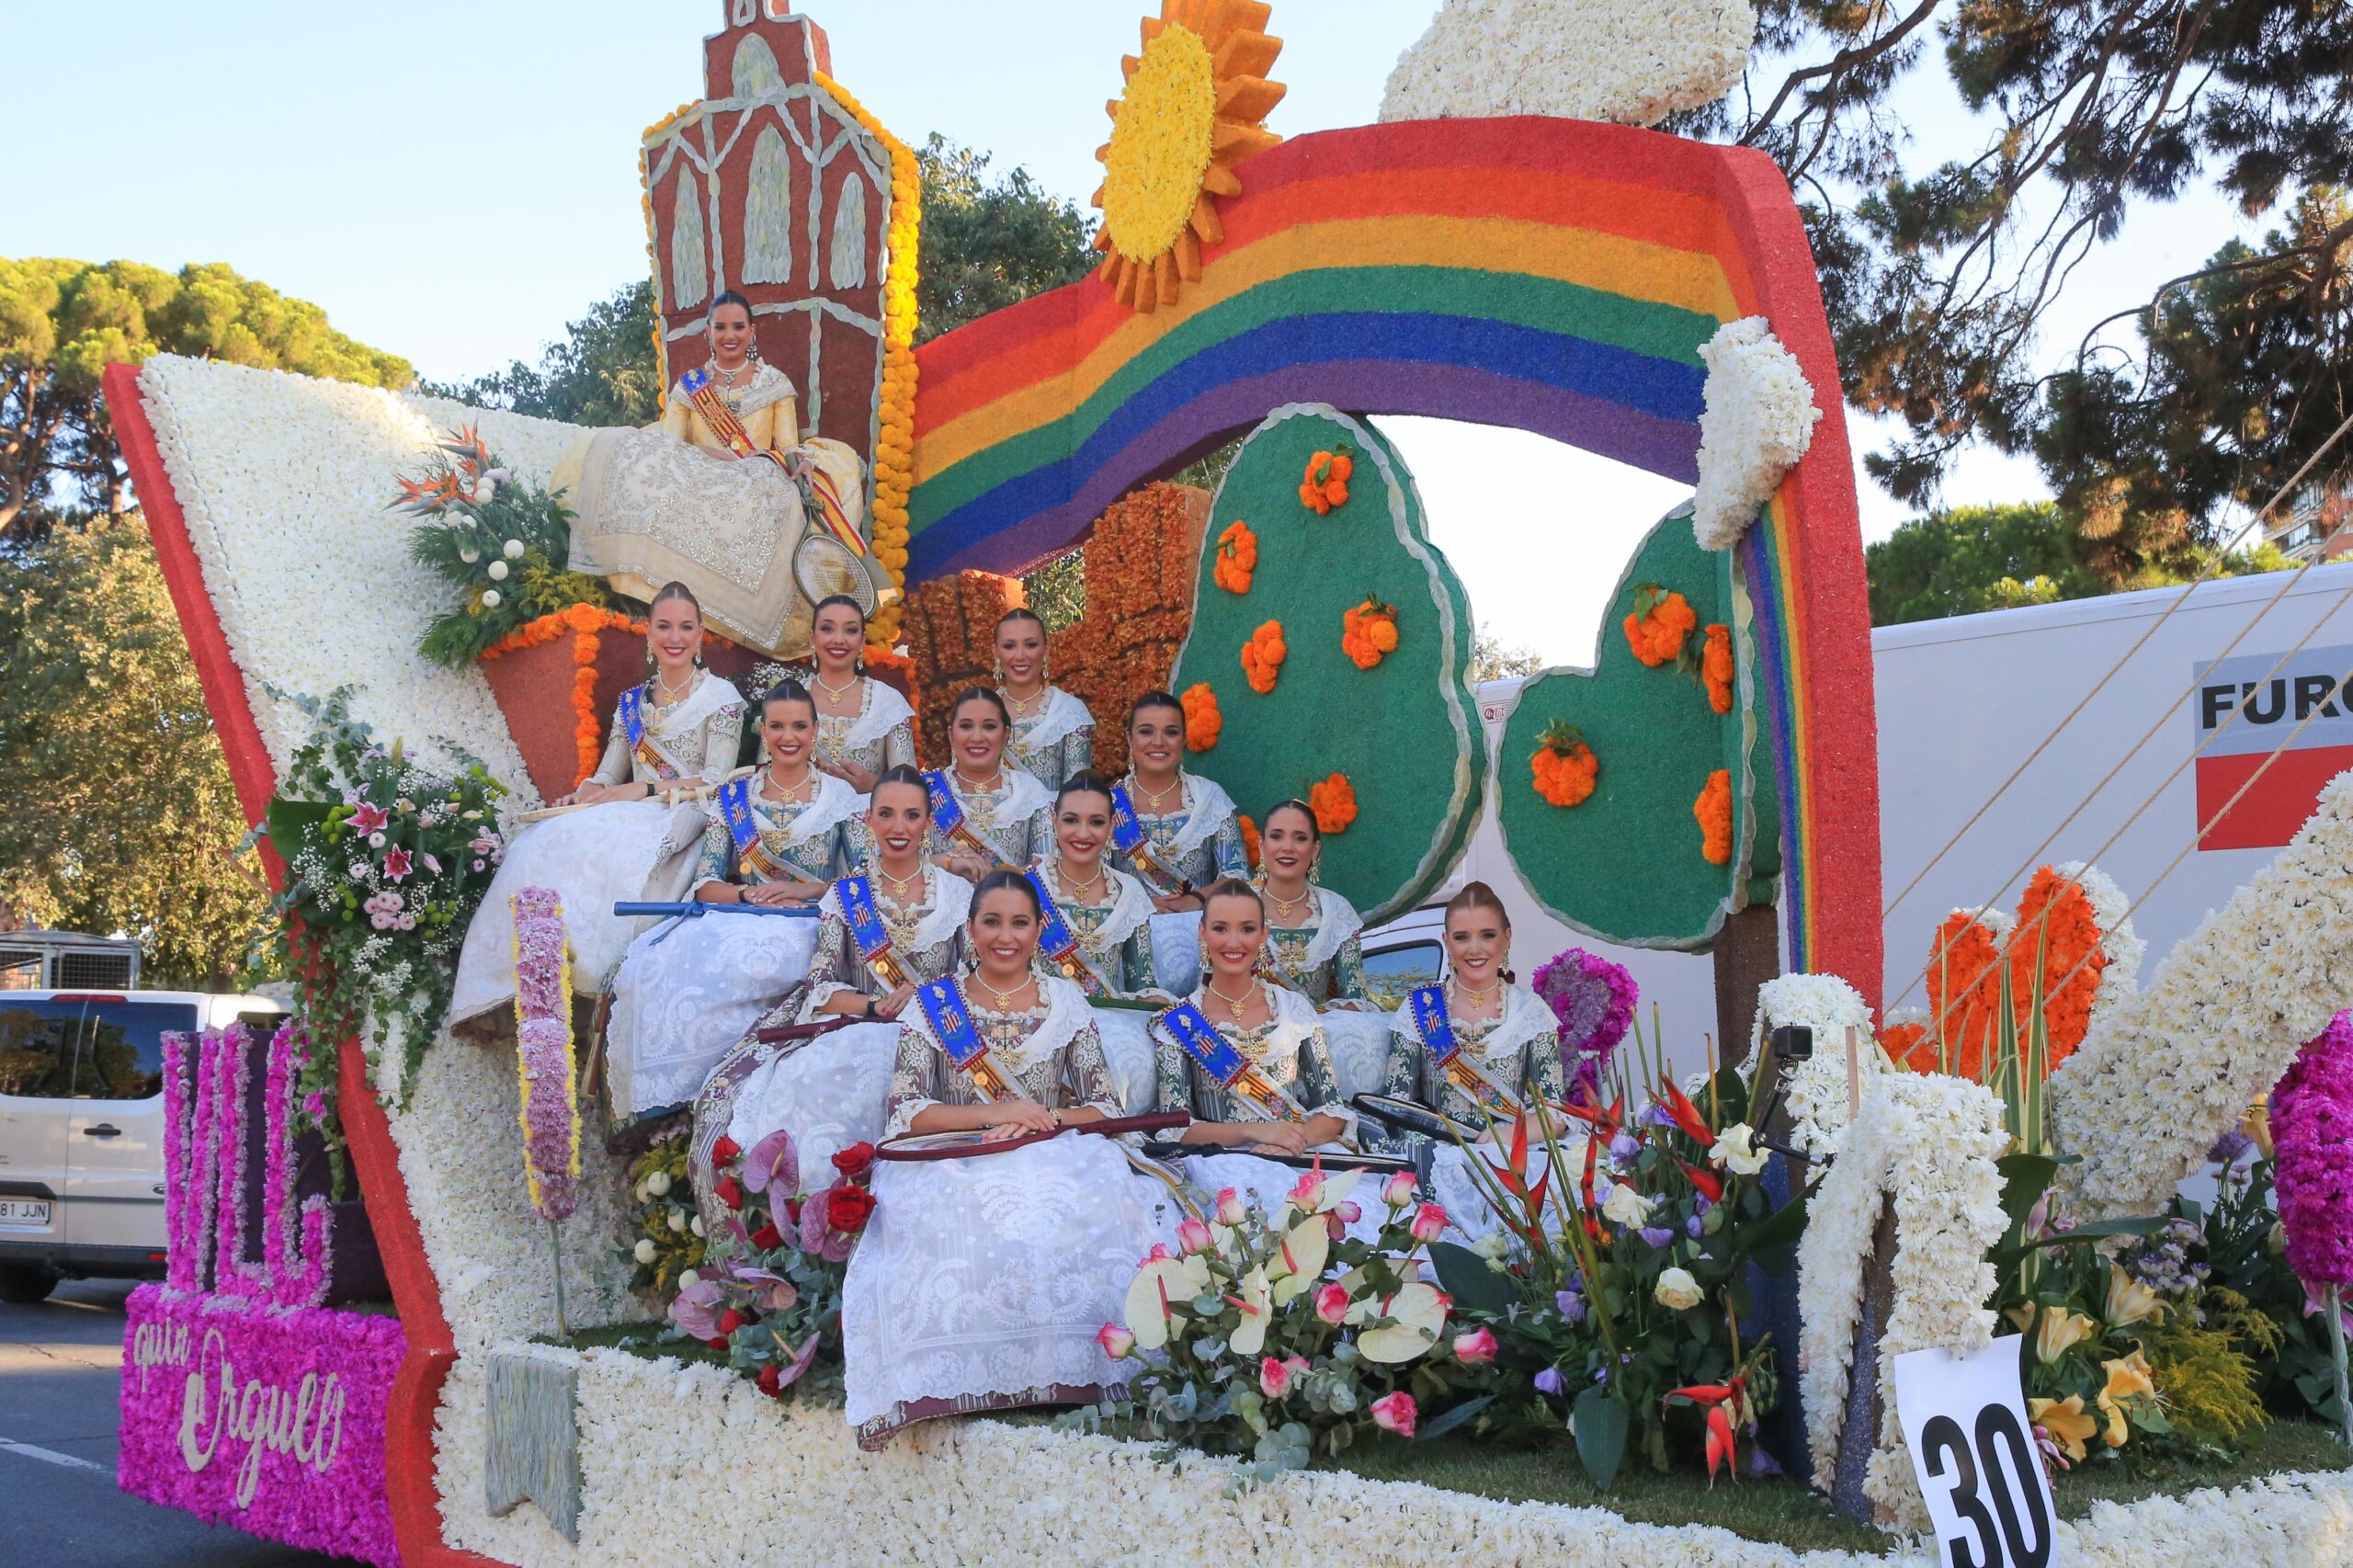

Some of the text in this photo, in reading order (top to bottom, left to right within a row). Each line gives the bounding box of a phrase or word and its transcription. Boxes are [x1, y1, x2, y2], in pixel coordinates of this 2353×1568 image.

[2202, 675, 2353, 730] FUR
[21, 1204, 46, 1218] JJN
[1921, 1403, 2051, 1568] 30
